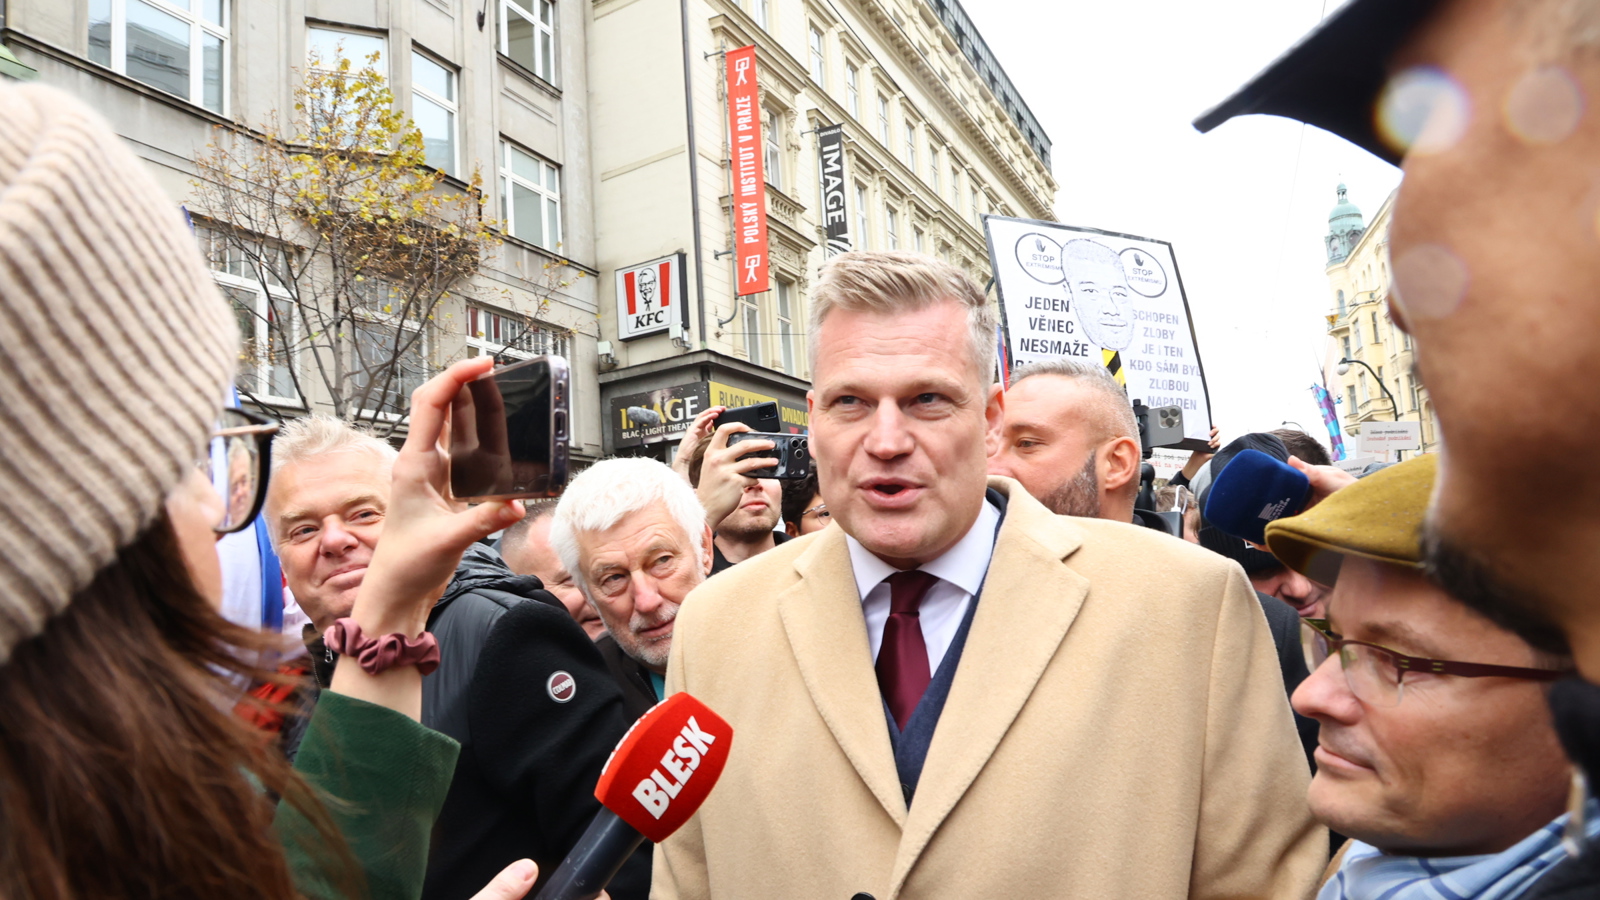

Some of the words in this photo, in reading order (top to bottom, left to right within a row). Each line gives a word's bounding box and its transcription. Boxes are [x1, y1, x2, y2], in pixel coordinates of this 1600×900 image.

[736, 95, 753, 130] PRAZE
[738, 134, 754, 144] V
[820, 128, 841, 137] DIVADLO
[740, 146, 756, 197] INSTITUT
[823, 142, 845, 226] IMAGE
[740, 203, 759, 244] POLSKÝ
[1032, 253, 1055, 263] STOP
[1025, 261, 1062, 271] EXTREMISM
[1132, 267, 1153, 276] STOP
[1025, 296, 1070, 313] JEDEN
[634, 310, 664, 329] KFC
[1028, 314, 1074, 334] VĚNEC
[1132, 309, 1179, 325] SCHOPEN
[1143, 326, 1175, 341] ZLOBY
[1020, 337, 1089, 357] NESMAŽE
[1142, 343, 1155, 355] JE
[1164, 345, 1183, 358] TEN
[1129, 359, 1152, 372] KDO
[1156, 360, 1178, 374] SÁM
[1182, 364, 1201, 377] BYL
[1149, 378, 1189, 392] ZLOBOU
[1147, 395, 1197, 410] NAPADEN
[622, 430, 645, 439] BLAC
[645, 426, 667, 436] LIGHT
[632, 715, 716, 820] BLESK
